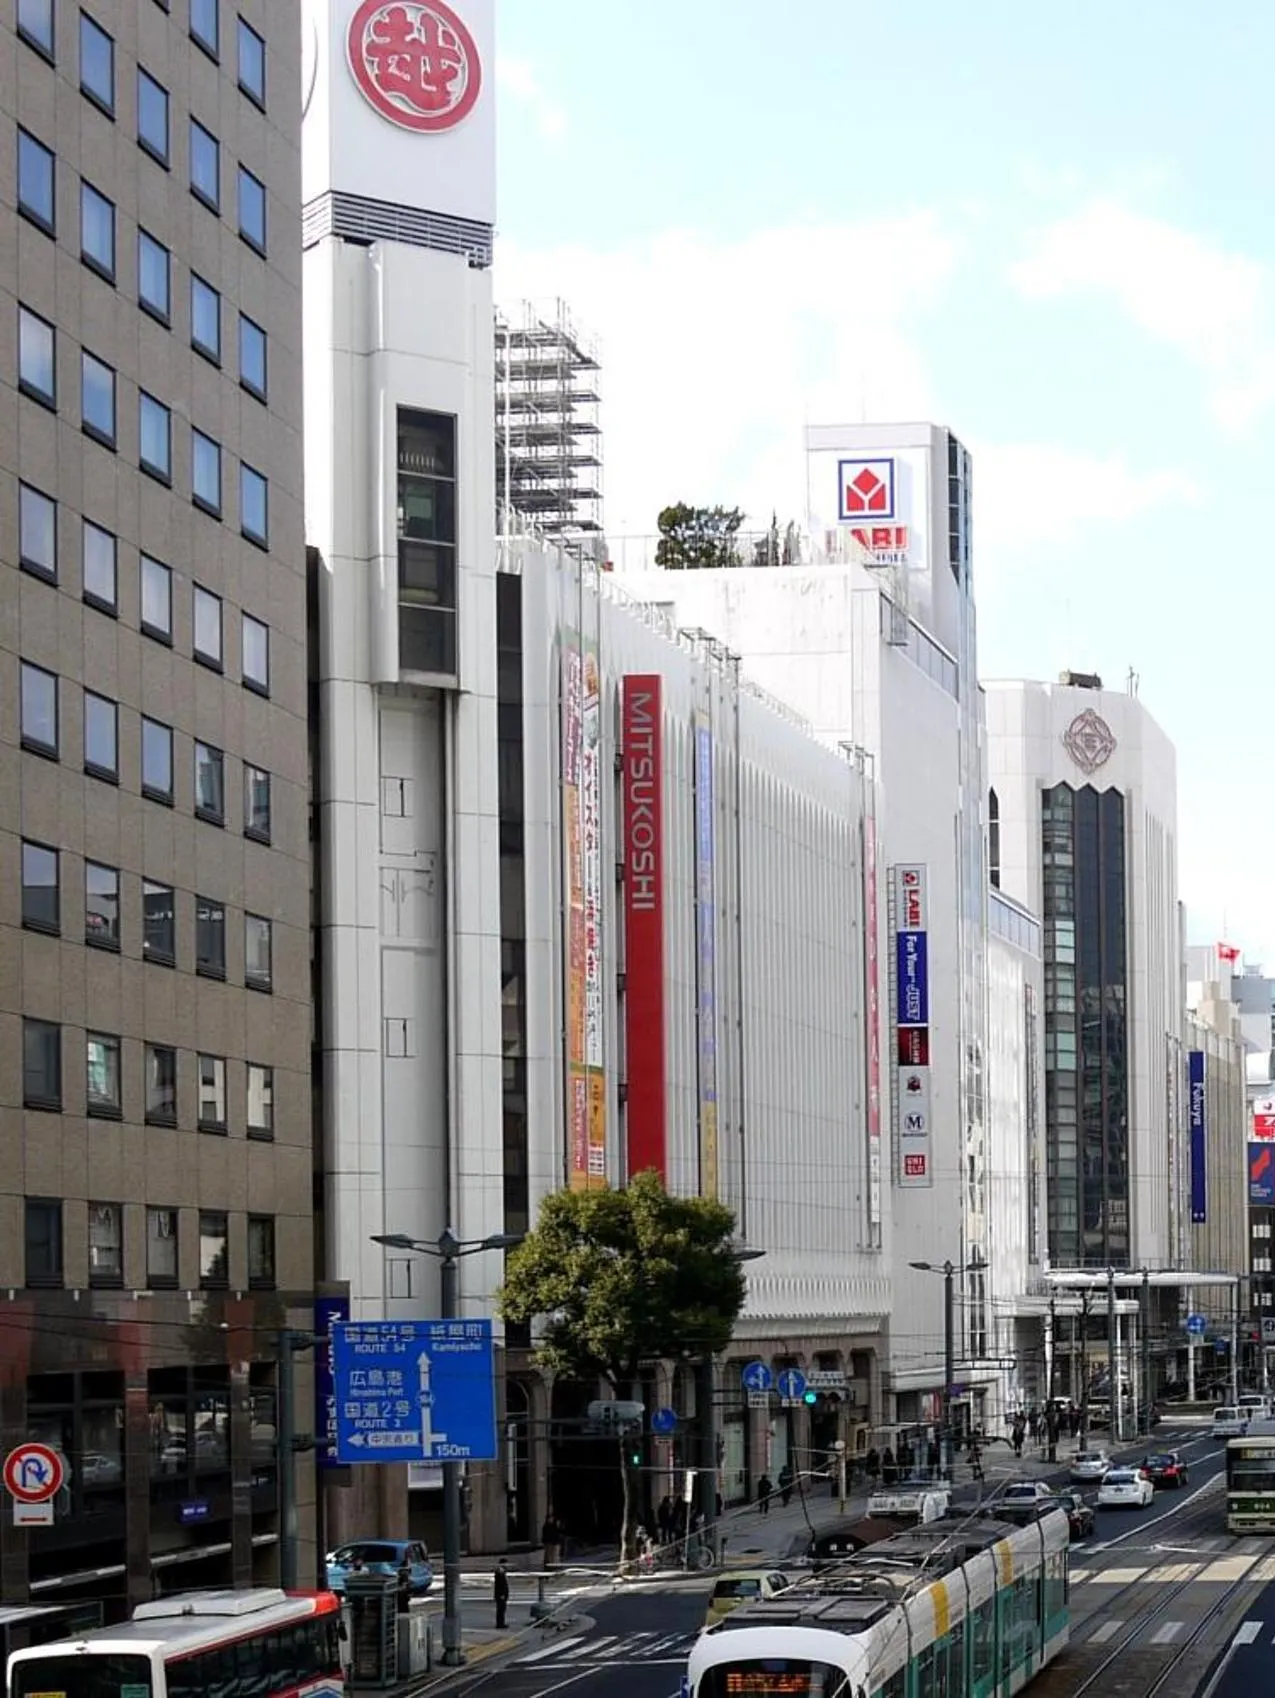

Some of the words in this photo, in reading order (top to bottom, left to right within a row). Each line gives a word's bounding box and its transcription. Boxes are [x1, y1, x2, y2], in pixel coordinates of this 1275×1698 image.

[630, 692, 655, 910] MITSUKOSHI
[909, 889, 920, 926] LABI
[354, 1344, 386, 1353] ROUTE
[354, 1419, 387, 1428] ROUTE
[436, 1444, 470, 1457] 150m
